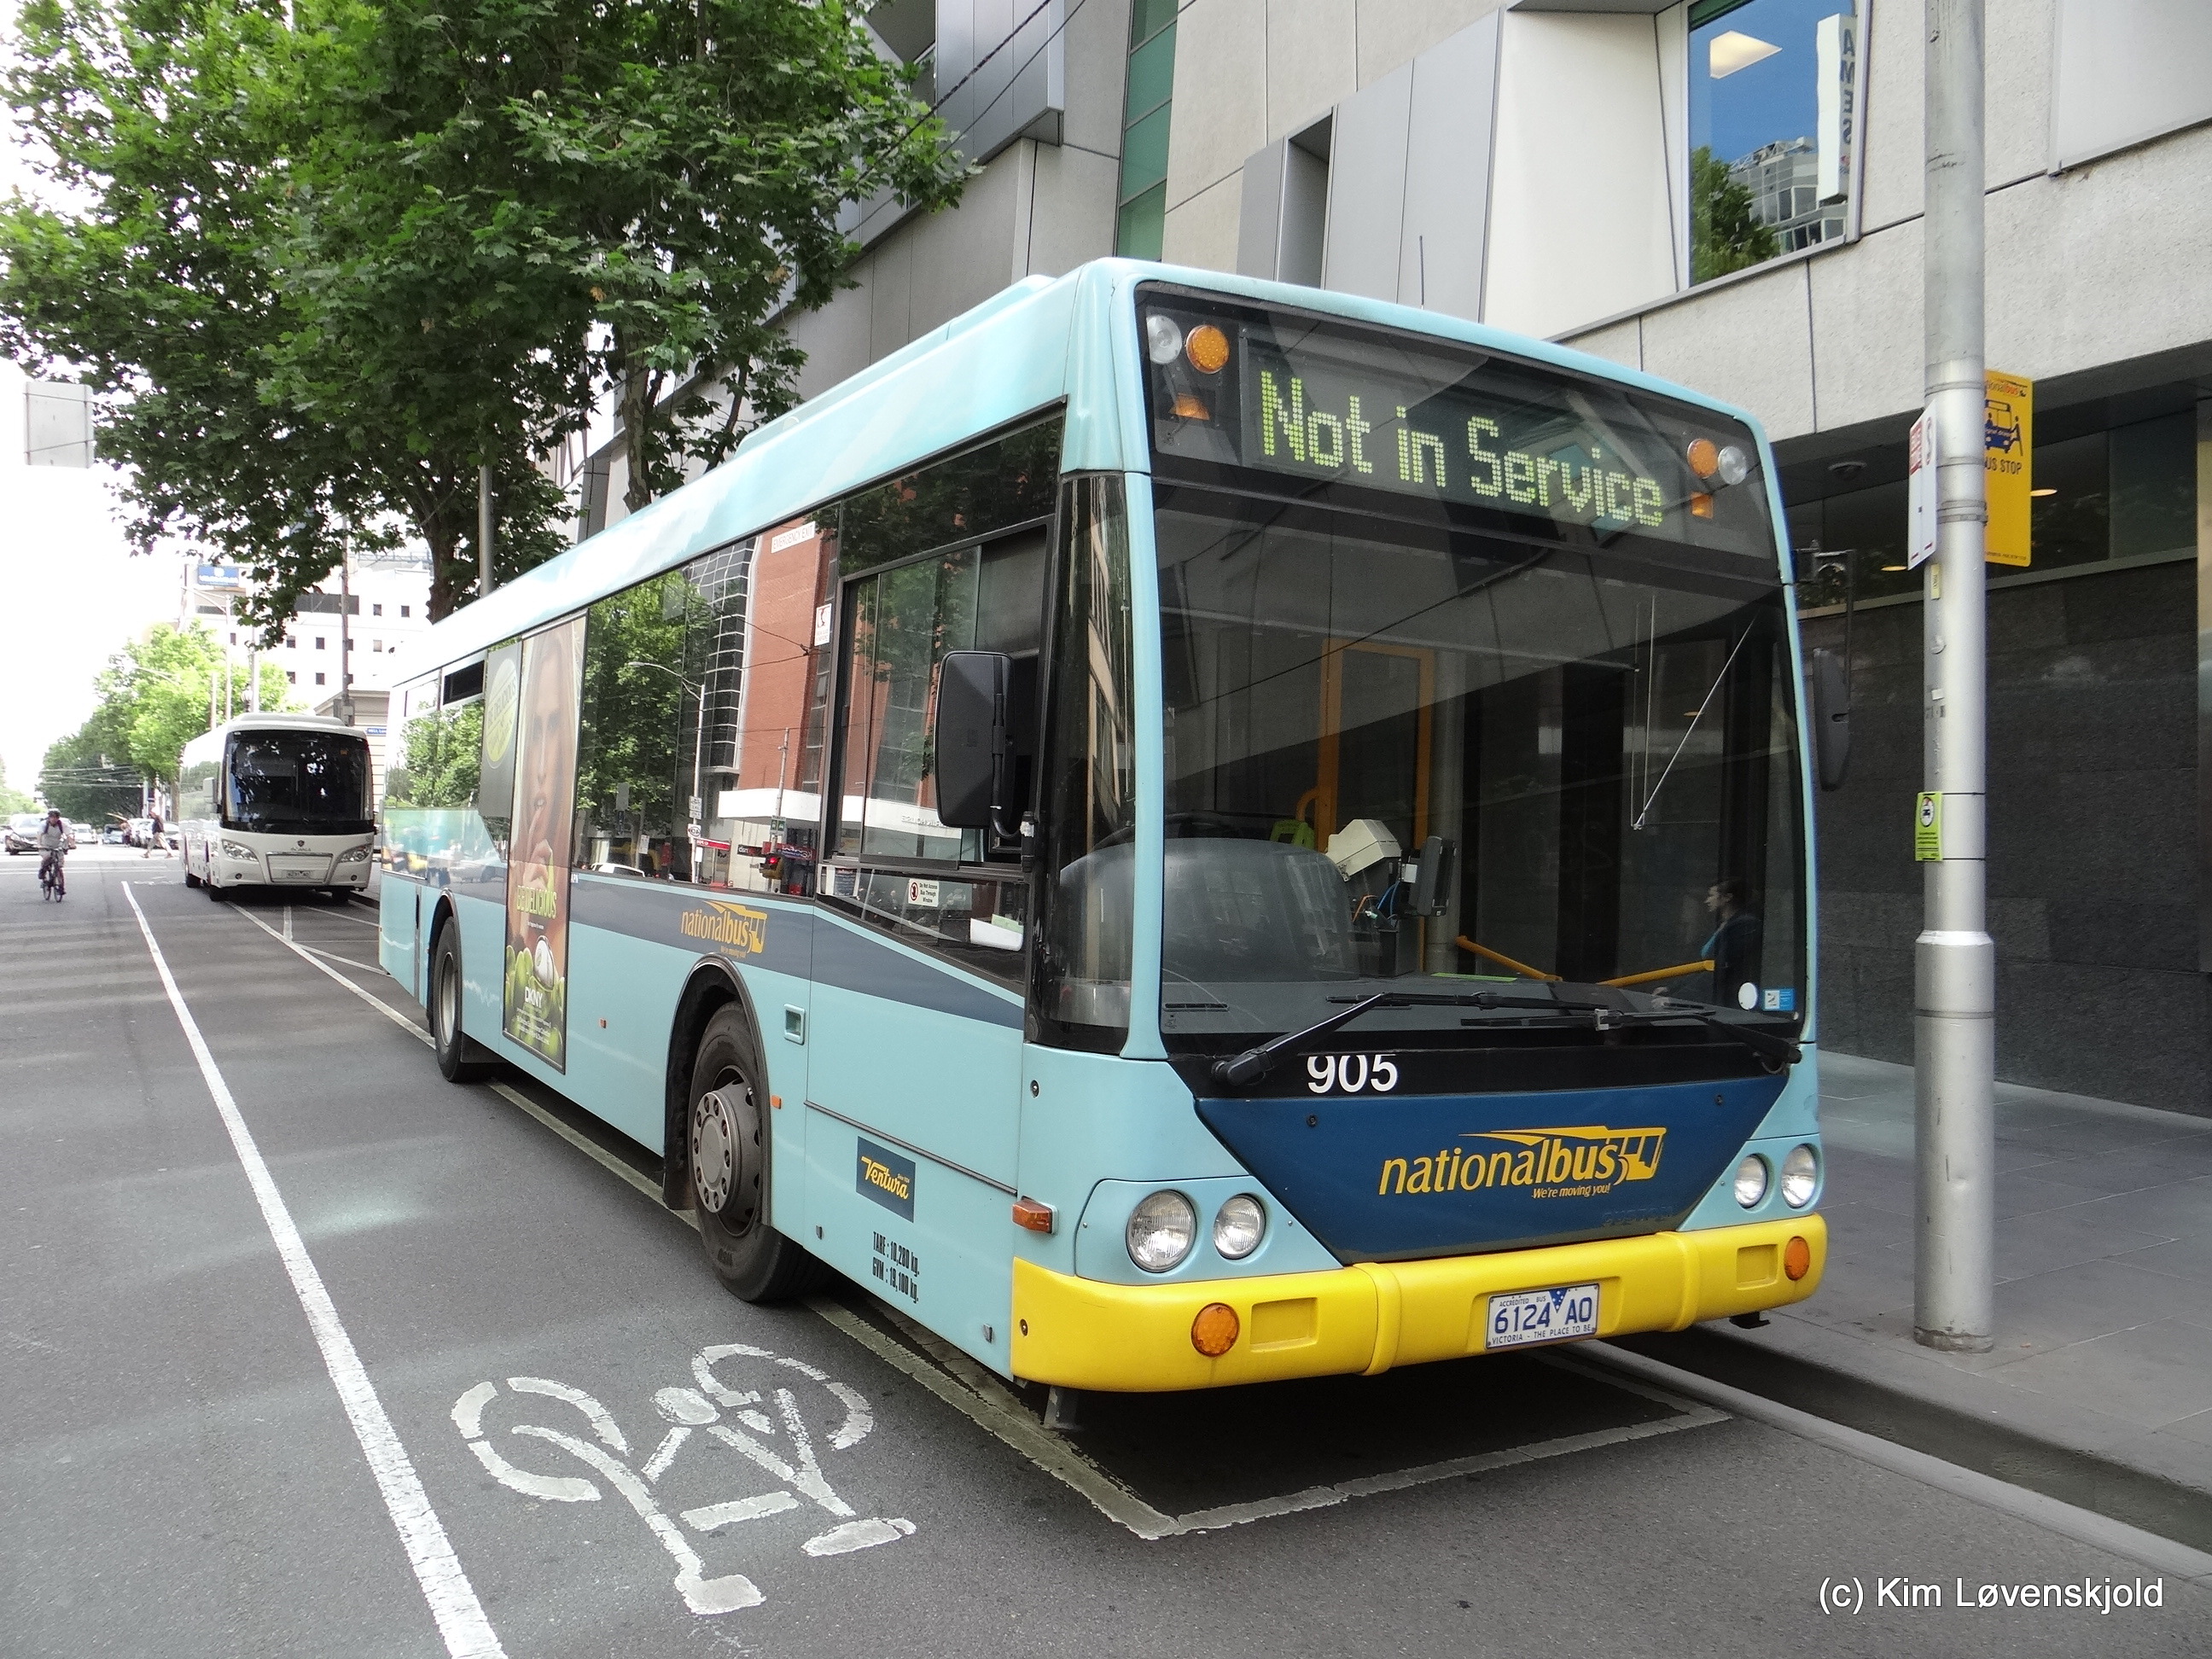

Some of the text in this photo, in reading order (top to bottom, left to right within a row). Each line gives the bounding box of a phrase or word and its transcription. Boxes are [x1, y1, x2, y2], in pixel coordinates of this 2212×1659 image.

[1260, 370, 1662, 527] Not in Service
[1985, 457, 2023, 474] US STOP
[802, 524, 813, 538] EXIT
[680, 908, 750, 947] nationalbus
[524, 986, 544, 1009] DKNY
[1307, 1054, 1399, 1094] 905
[861, 1155, 910, 1200] Ventura
[1378, 1137, 1618, 1196] nationalbus
[1533, 1183, 1611, 1199] We're moving you!
[873, 1231, 886, 1256] TARE
[872, 1256, 884, 1281] GVM
[889, 1266, 909, 1295] 19,100
[1499, 1298, 1529, 1307] ACCREDITED
[1494, 1301, 1551, 1334] 6124
[1492, 1333, 1523, 1345] VICTORIA
[1534, 1330, 1545, 1338] THE
[1550, 1327, 1569, 1336] PLACE
[1583, 1324, 1591, 1332] BE
